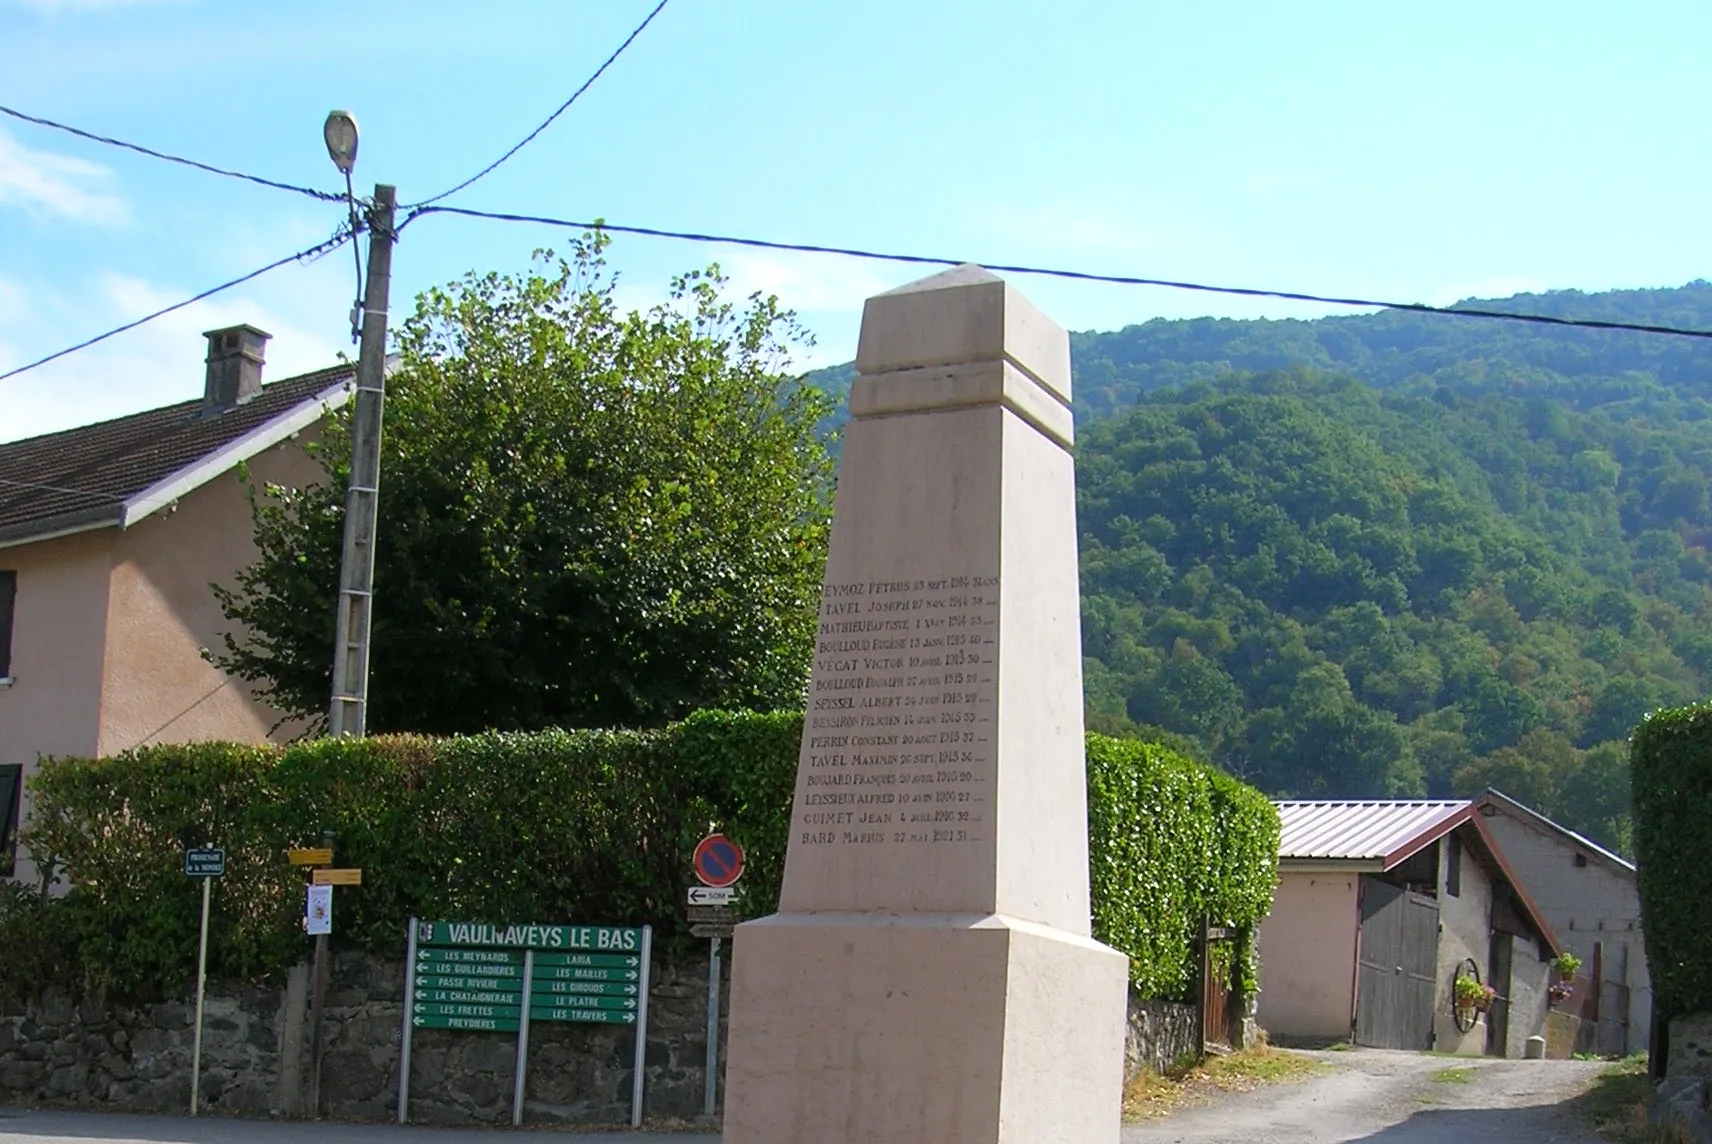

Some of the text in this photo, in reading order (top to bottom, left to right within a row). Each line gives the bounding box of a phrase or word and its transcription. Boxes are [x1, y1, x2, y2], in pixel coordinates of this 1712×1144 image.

[825, 603, 861, 616] TAVEL
[868, 600, 909, 613] JOSEPH
[820, 640, 870, 654] BOULLOUD
[864, 657, 905, 670] VICTOR
[810, 736, 849, 749] PERRIN
[810, 756, 847, 768] TAVEL
[857, 792, 895, 804] ALFRED
[859, 811, 893, 824] JEAN
[802, 832, 836, 845] BARD
[842, 831, 885, 844] MARIUS
[449, 924, 636, 950] VAULNAVEYS LE BAS
[445, 952, 460, 961] LES
[437, 964, 452, 973] LES
[556, 968, 571, 978] LES
[439, 978, 464, 988] PASSE
[552, 982, 567, 992] LES
[435, 992, 447, 1001] LA
[556, 996, 567, 1006] LE
[440, 1005, 456, 1015] LES
[553, 1010, 567, 1019] LES
